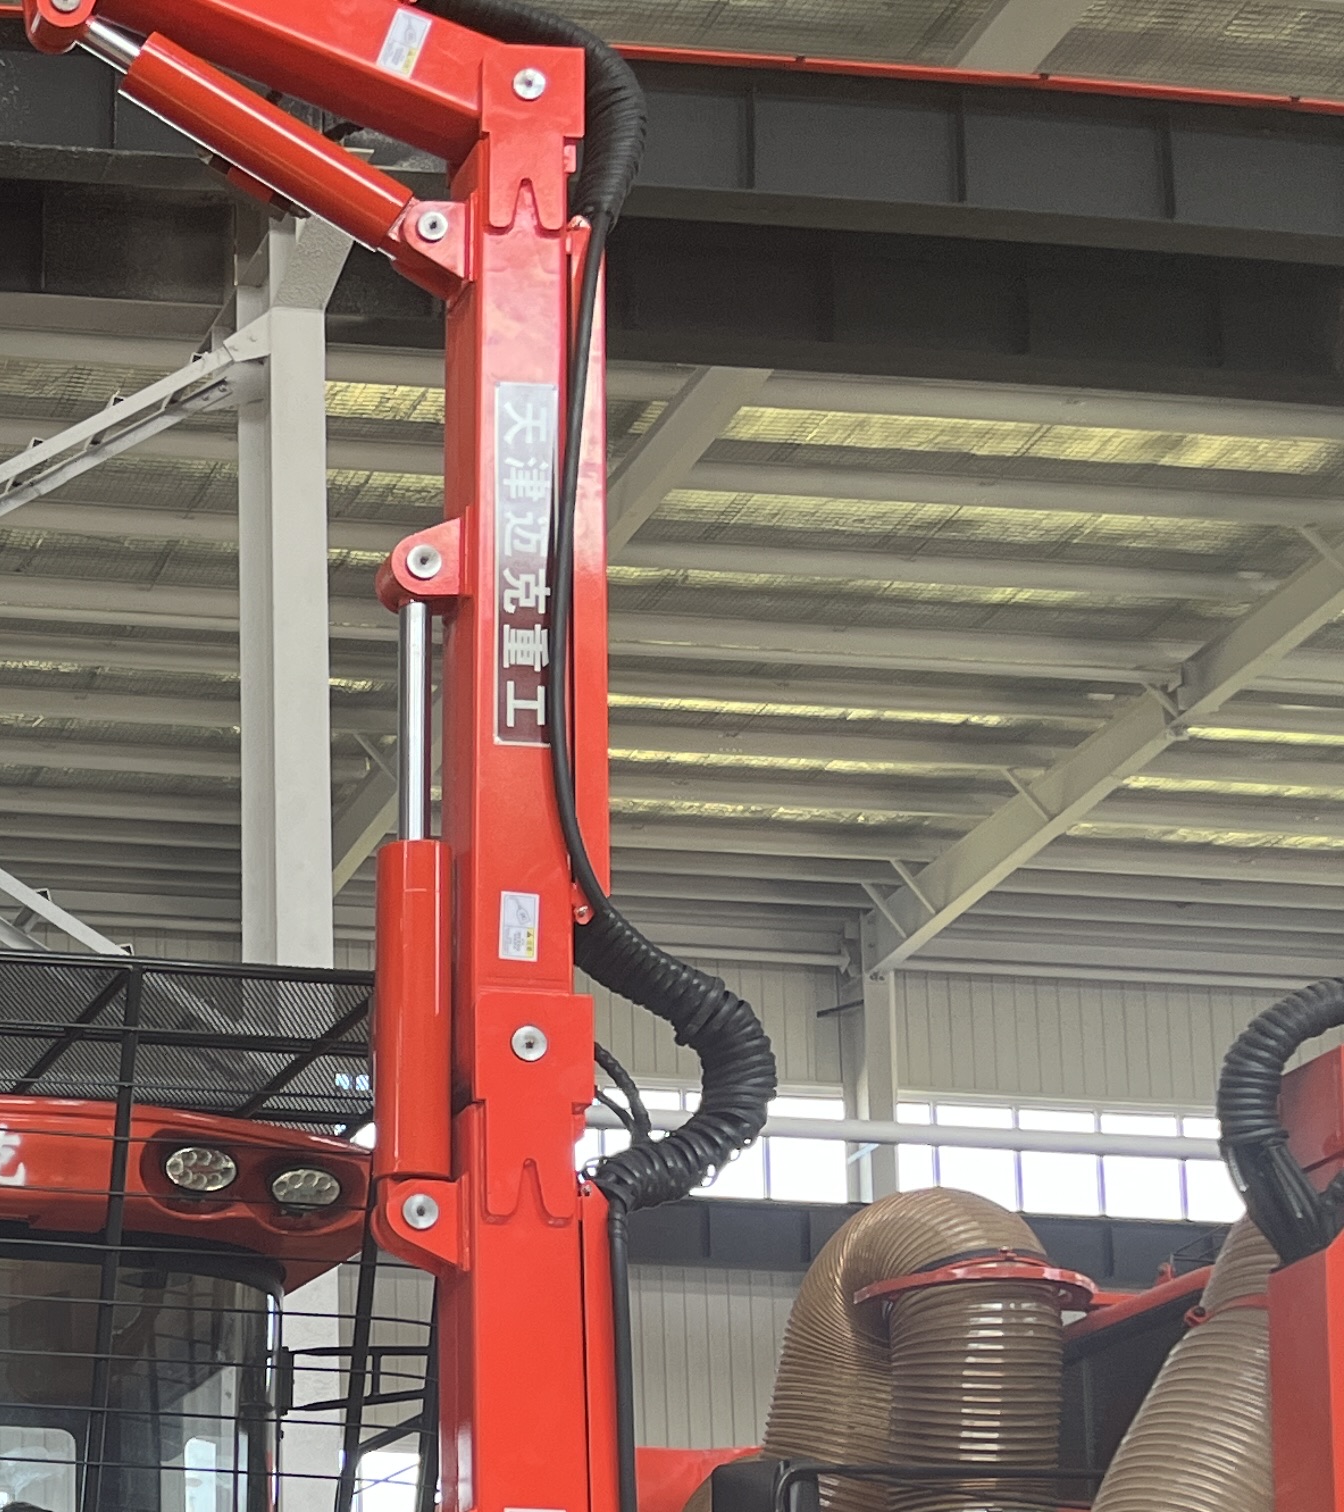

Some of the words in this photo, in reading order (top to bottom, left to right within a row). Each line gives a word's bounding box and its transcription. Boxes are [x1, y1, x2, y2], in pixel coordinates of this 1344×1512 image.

[502, 402, 550, 728] 天津迈克重工
